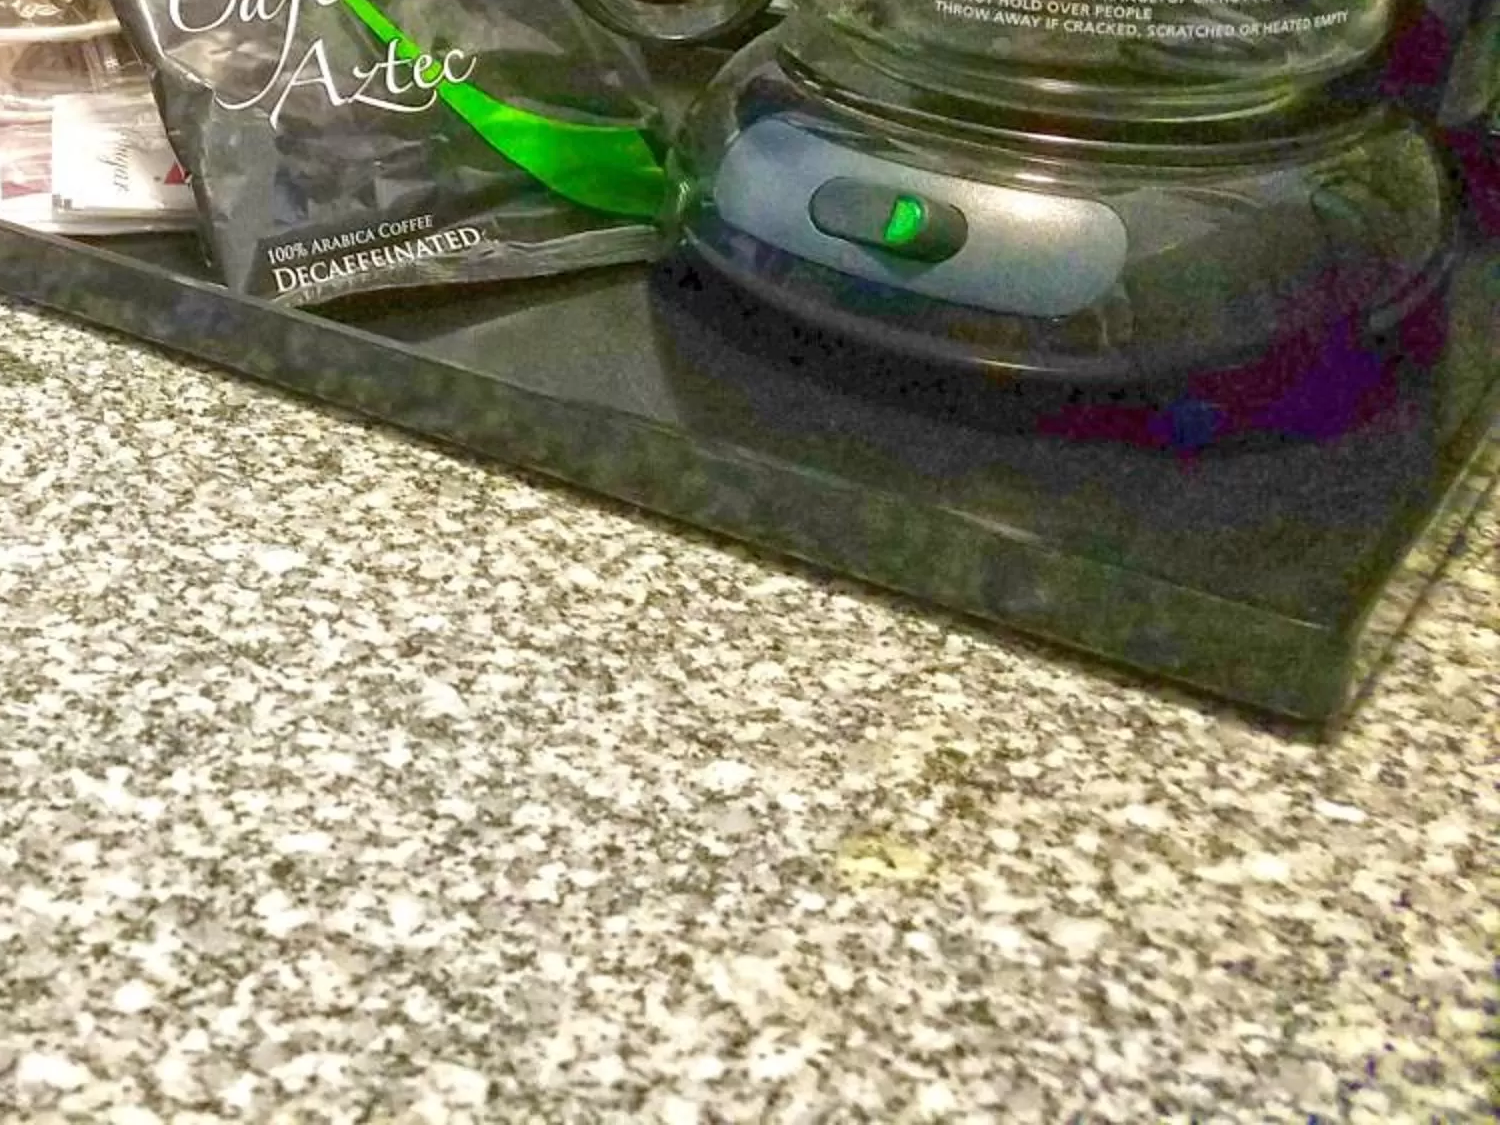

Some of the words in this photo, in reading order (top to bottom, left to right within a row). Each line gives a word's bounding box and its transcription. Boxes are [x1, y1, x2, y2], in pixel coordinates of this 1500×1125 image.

[935, 0, 991, 21] THROW
[993, 11, 1043, 28] AWAY
[1046, 17, 1059, 30] IF
[1147, 24, 1235, 39] SCRATCHED
[1239, 23, 1260, 37] OR
[1263, 19, 1312, 35] HEATED
[1314, 8, 1349, 28] EMPTY
[1047, 1, 1091, 17] OVER
[1095, 4, 1154, 20] PEOPLE
[269, 38, 477, 131] Aztec
[267, 241, 308, 265] 100%
[311, 228, 375, 255] ARABICA
[378, 214, 433, 239] COFFEE
[271, 226, 482, 294] DECAFFEINATED
